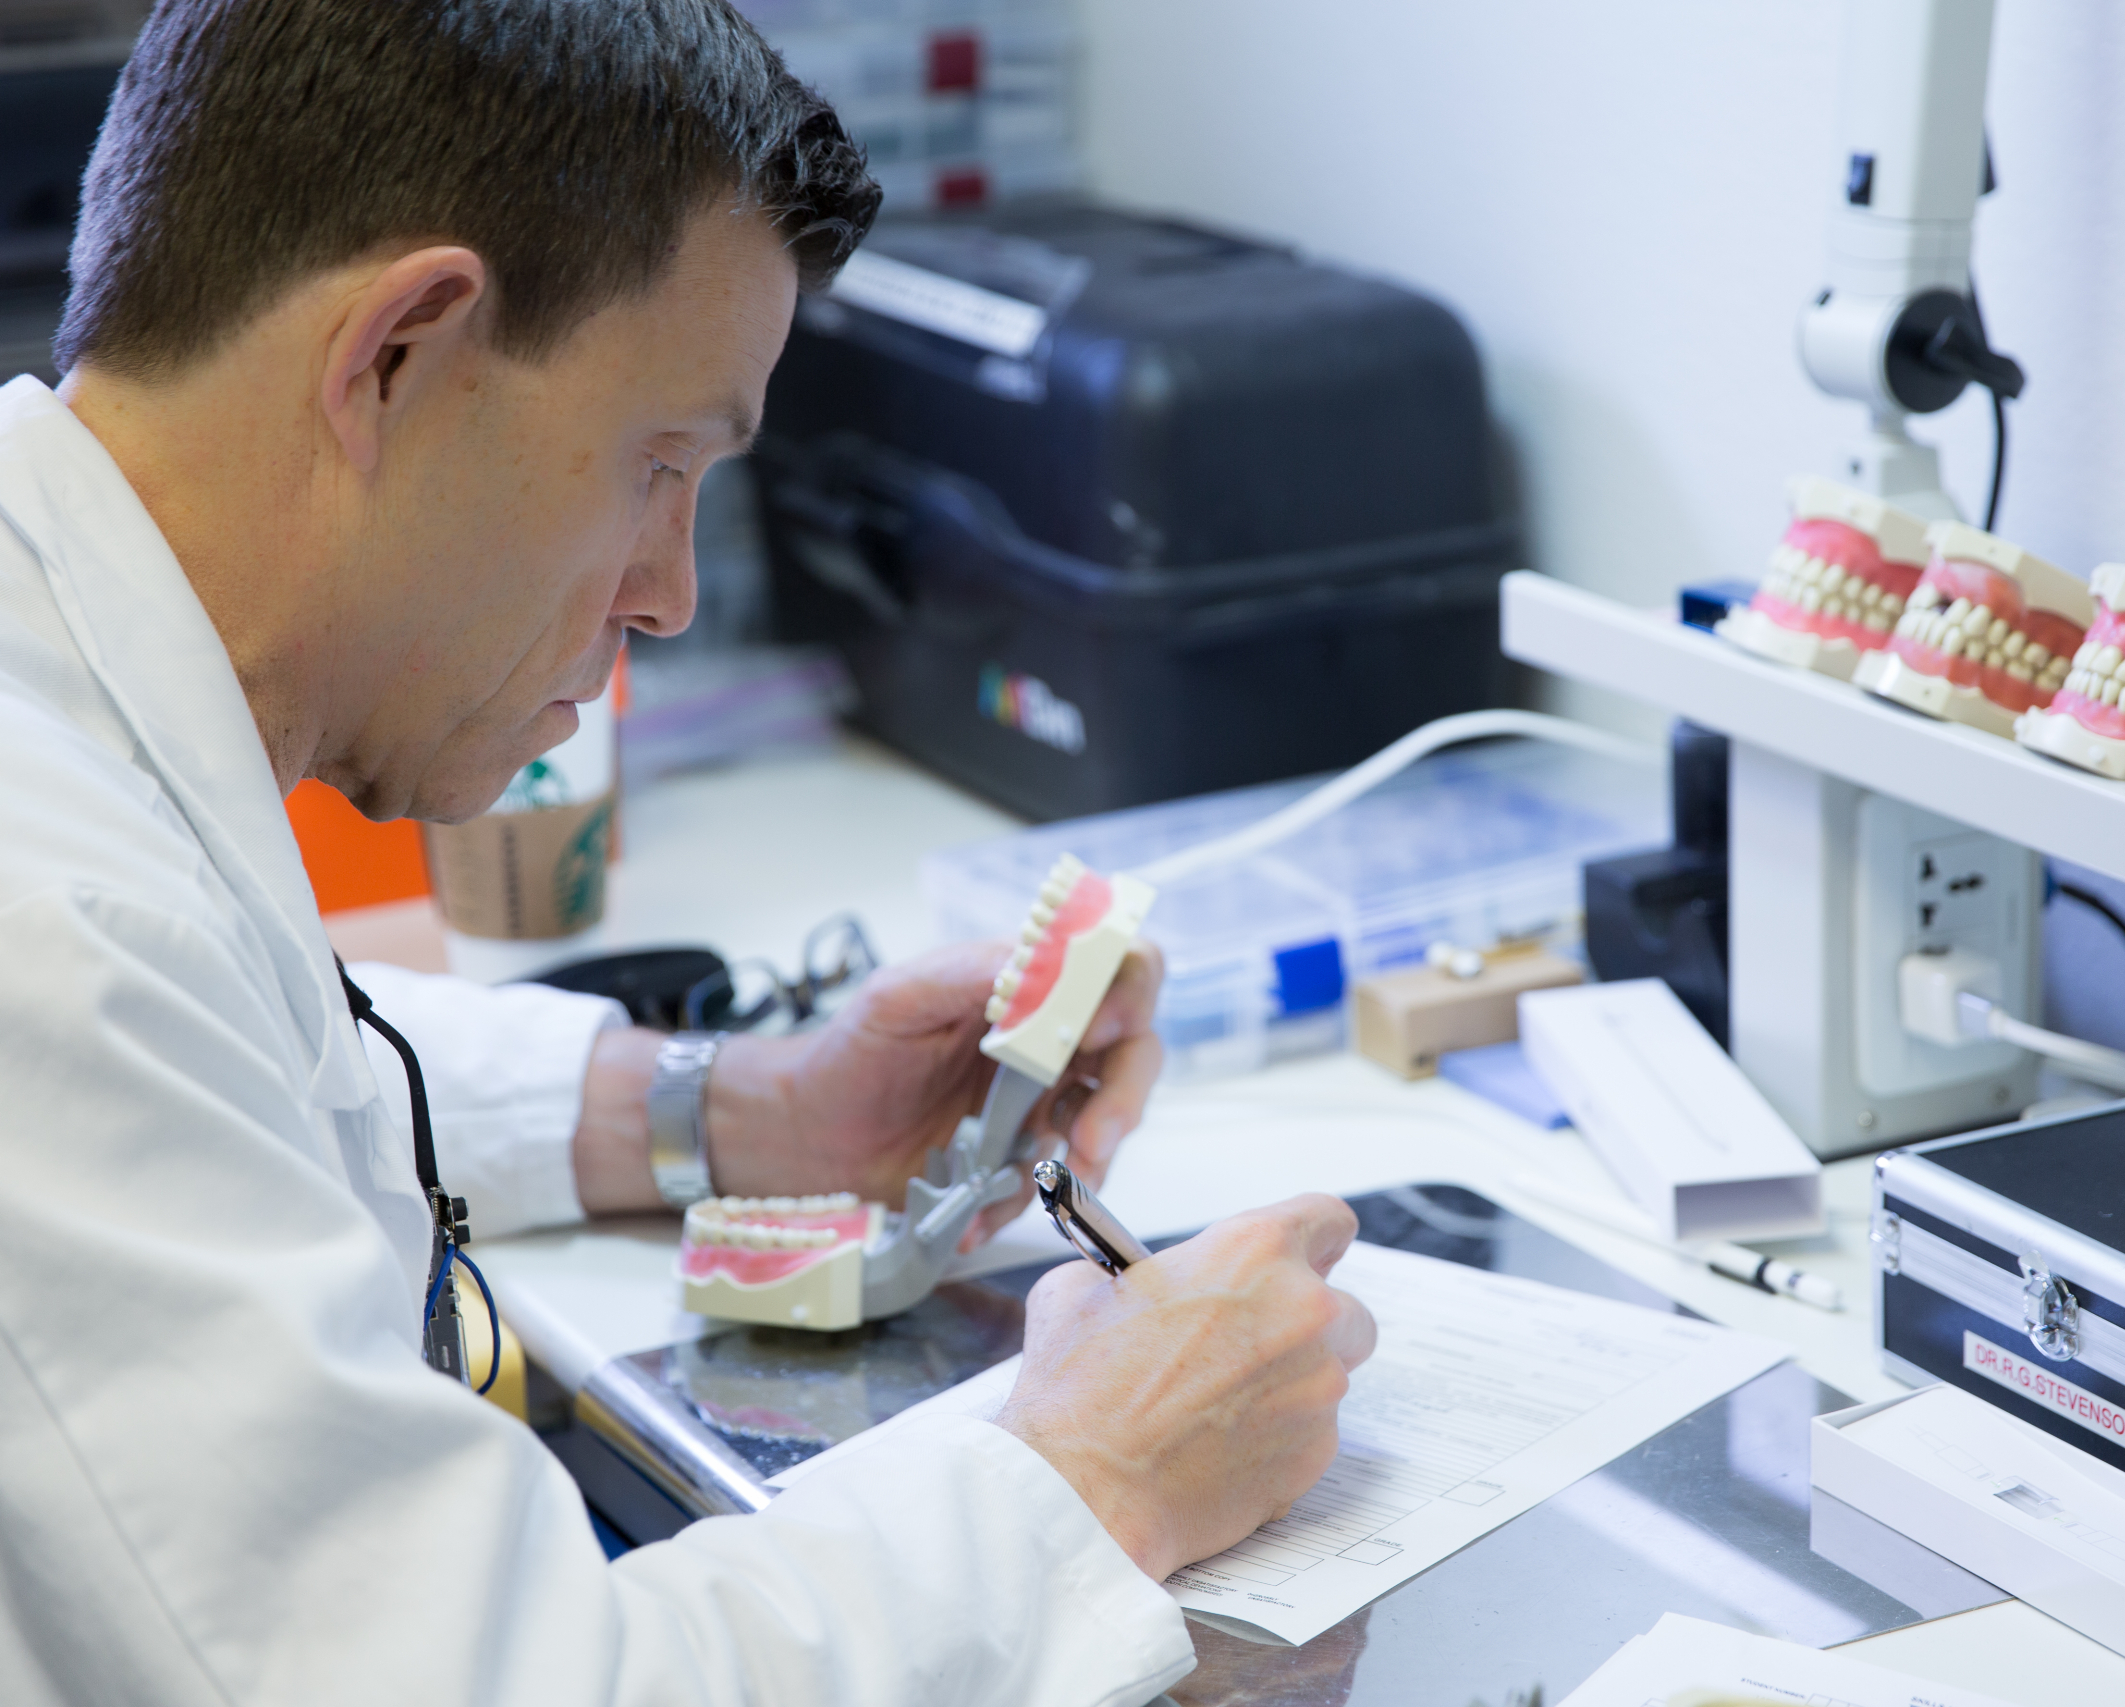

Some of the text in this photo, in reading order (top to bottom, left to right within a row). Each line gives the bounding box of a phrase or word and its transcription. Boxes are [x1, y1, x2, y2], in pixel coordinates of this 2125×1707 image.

[1373, 1537, 1403, 1548] GRADE
[1189, 1567, 1214, 1577] BOTTOM
[1741, 1677, 1774, 1690] STUDENT
